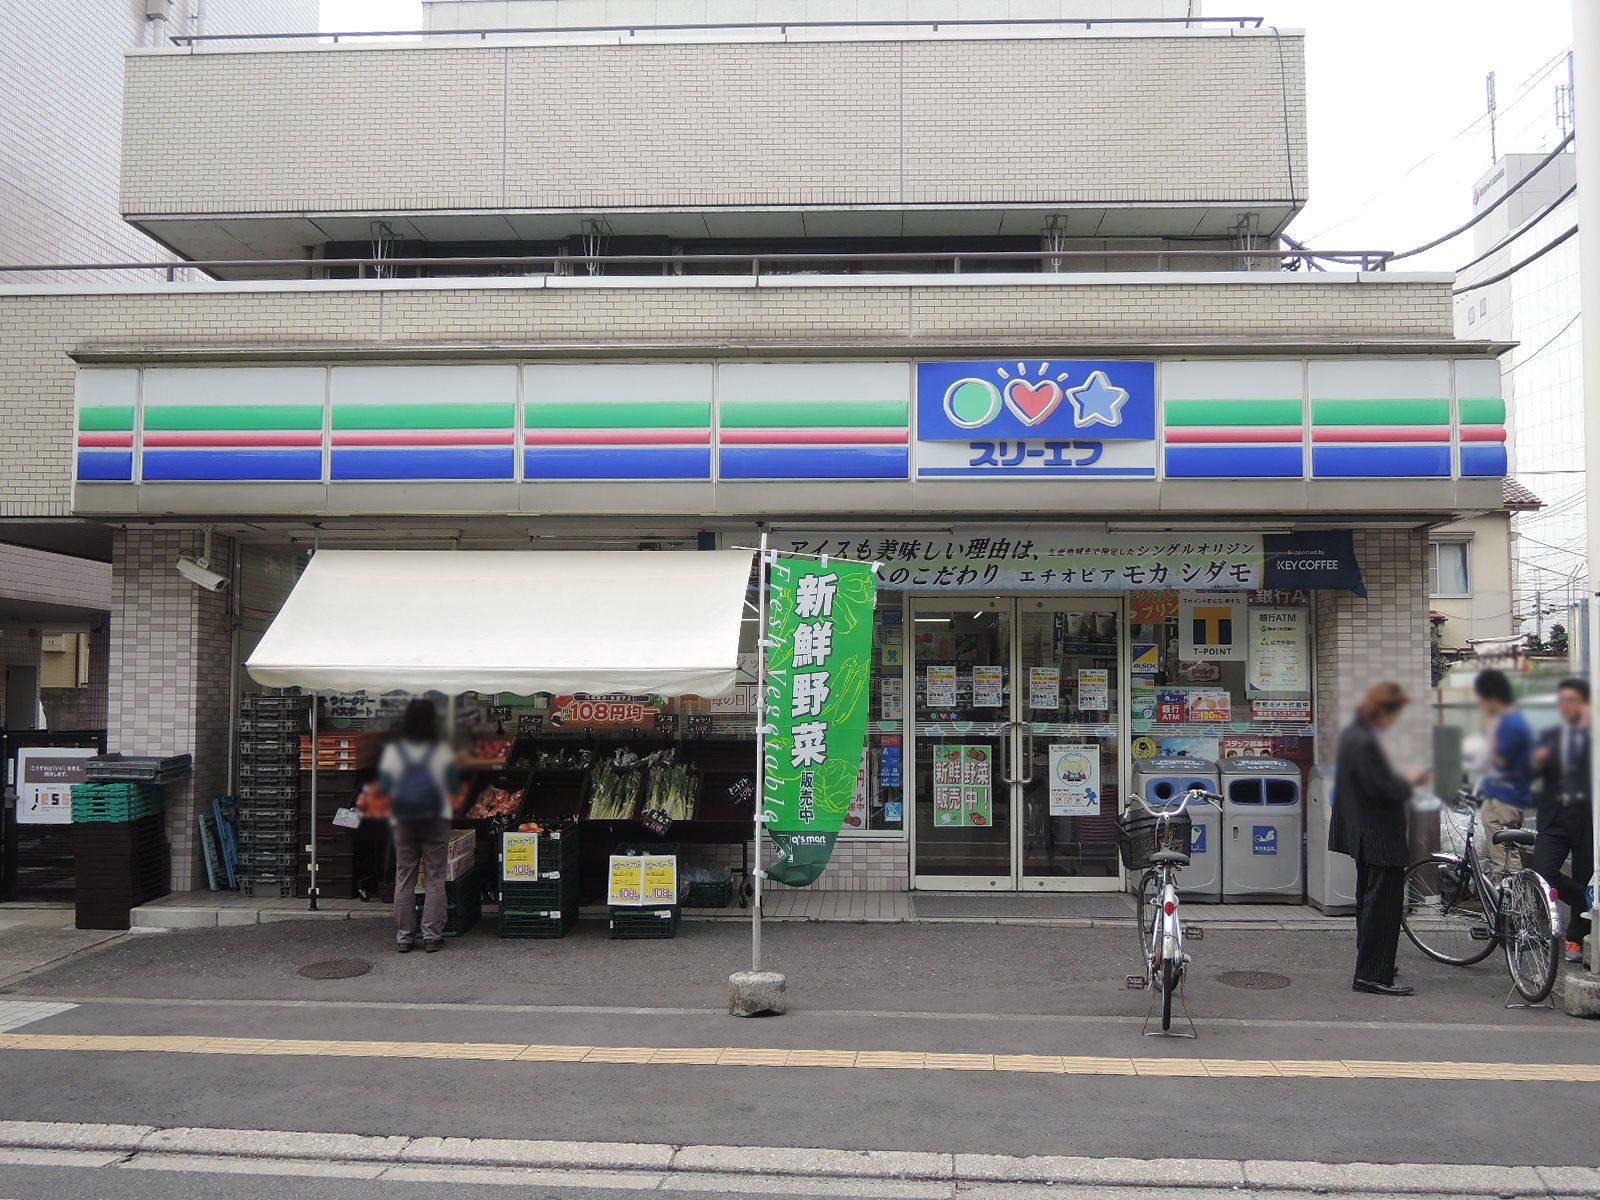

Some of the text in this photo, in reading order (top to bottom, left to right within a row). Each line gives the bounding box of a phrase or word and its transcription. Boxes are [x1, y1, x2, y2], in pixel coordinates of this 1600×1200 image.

[969, 441, 1103, 467] スリーエフ
[1019, 569, 1116, 584] エチオピア
[1123, 562, 1169, 585] モカ
[1182, 561, 1251, 585] シダモ
[1259, 613, 1296, 623] 銀行ATM
[1193, 647, 1233, 656] T-POINT
[791, 571, 838, 769] 新鮮野菜
[1162, 704, 1180, 714] 銀行
[1162, 713, 1180, 721] ATM
[764, 668, 788, 824] Vegetable
[799, 770, 815, 824] 販売中
[514, 865, 529, 874] 108
